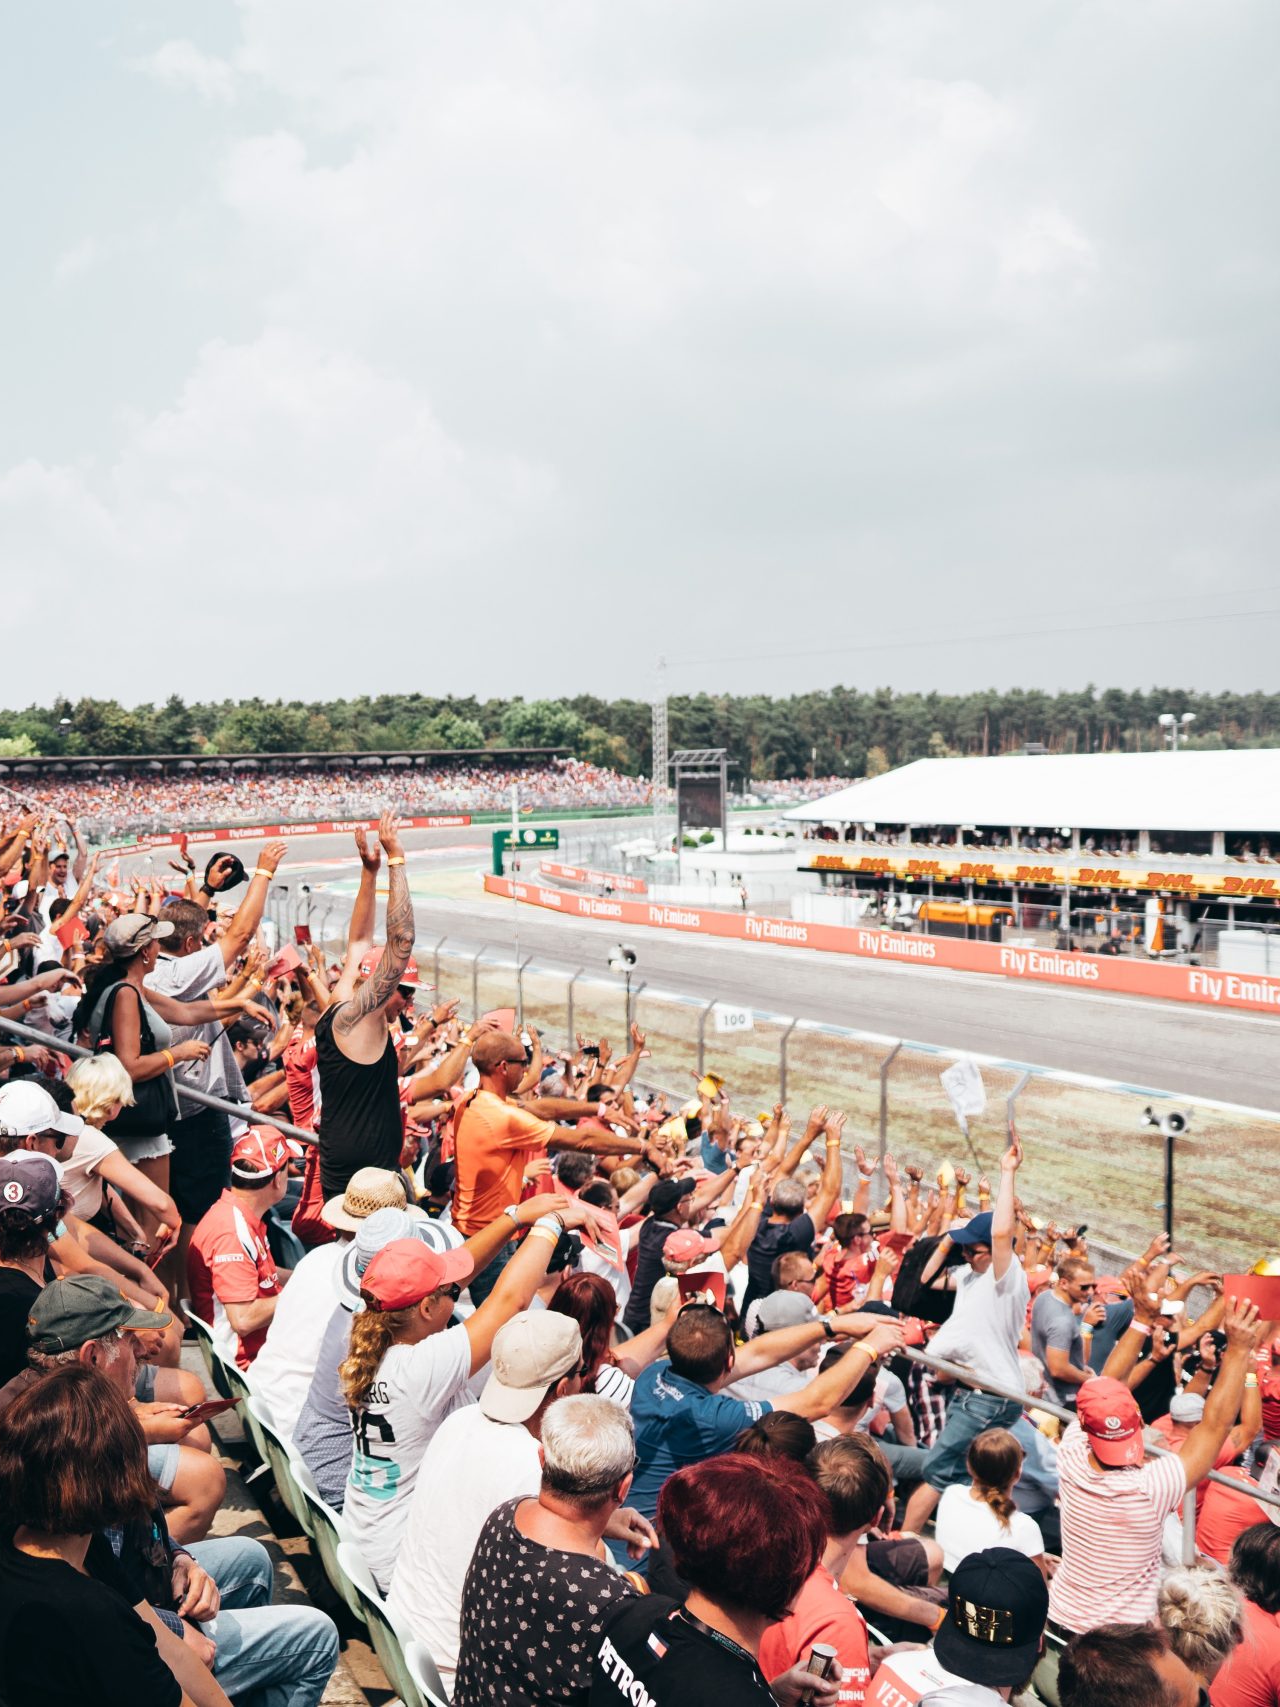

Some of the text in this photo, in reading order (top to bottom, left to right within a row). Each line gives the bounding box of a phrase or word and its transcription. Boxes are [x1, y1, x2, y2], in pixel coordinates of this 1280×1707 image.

[1017, 866, 1056, 880] DHL
[1078, 868, 1121, 883] DHL
[1147, 872, 1195, 888] DHL
[1222, 876, 1280, 894] DHL
[579, 898, 622, 917] Fly Emirates
[649, 906, 700, 927] Fly Emirates
[745, 917, 807, 942] Fly Emirates
[859, 931, 935, 958] Fly Emirates
[1000, 948, 1099, 980] Fly Emirates
[1188, 971, 1222, 1000] Fly
[724, 1014, 746, 1026] 100
[9, 1184, 19, 1200] 3
